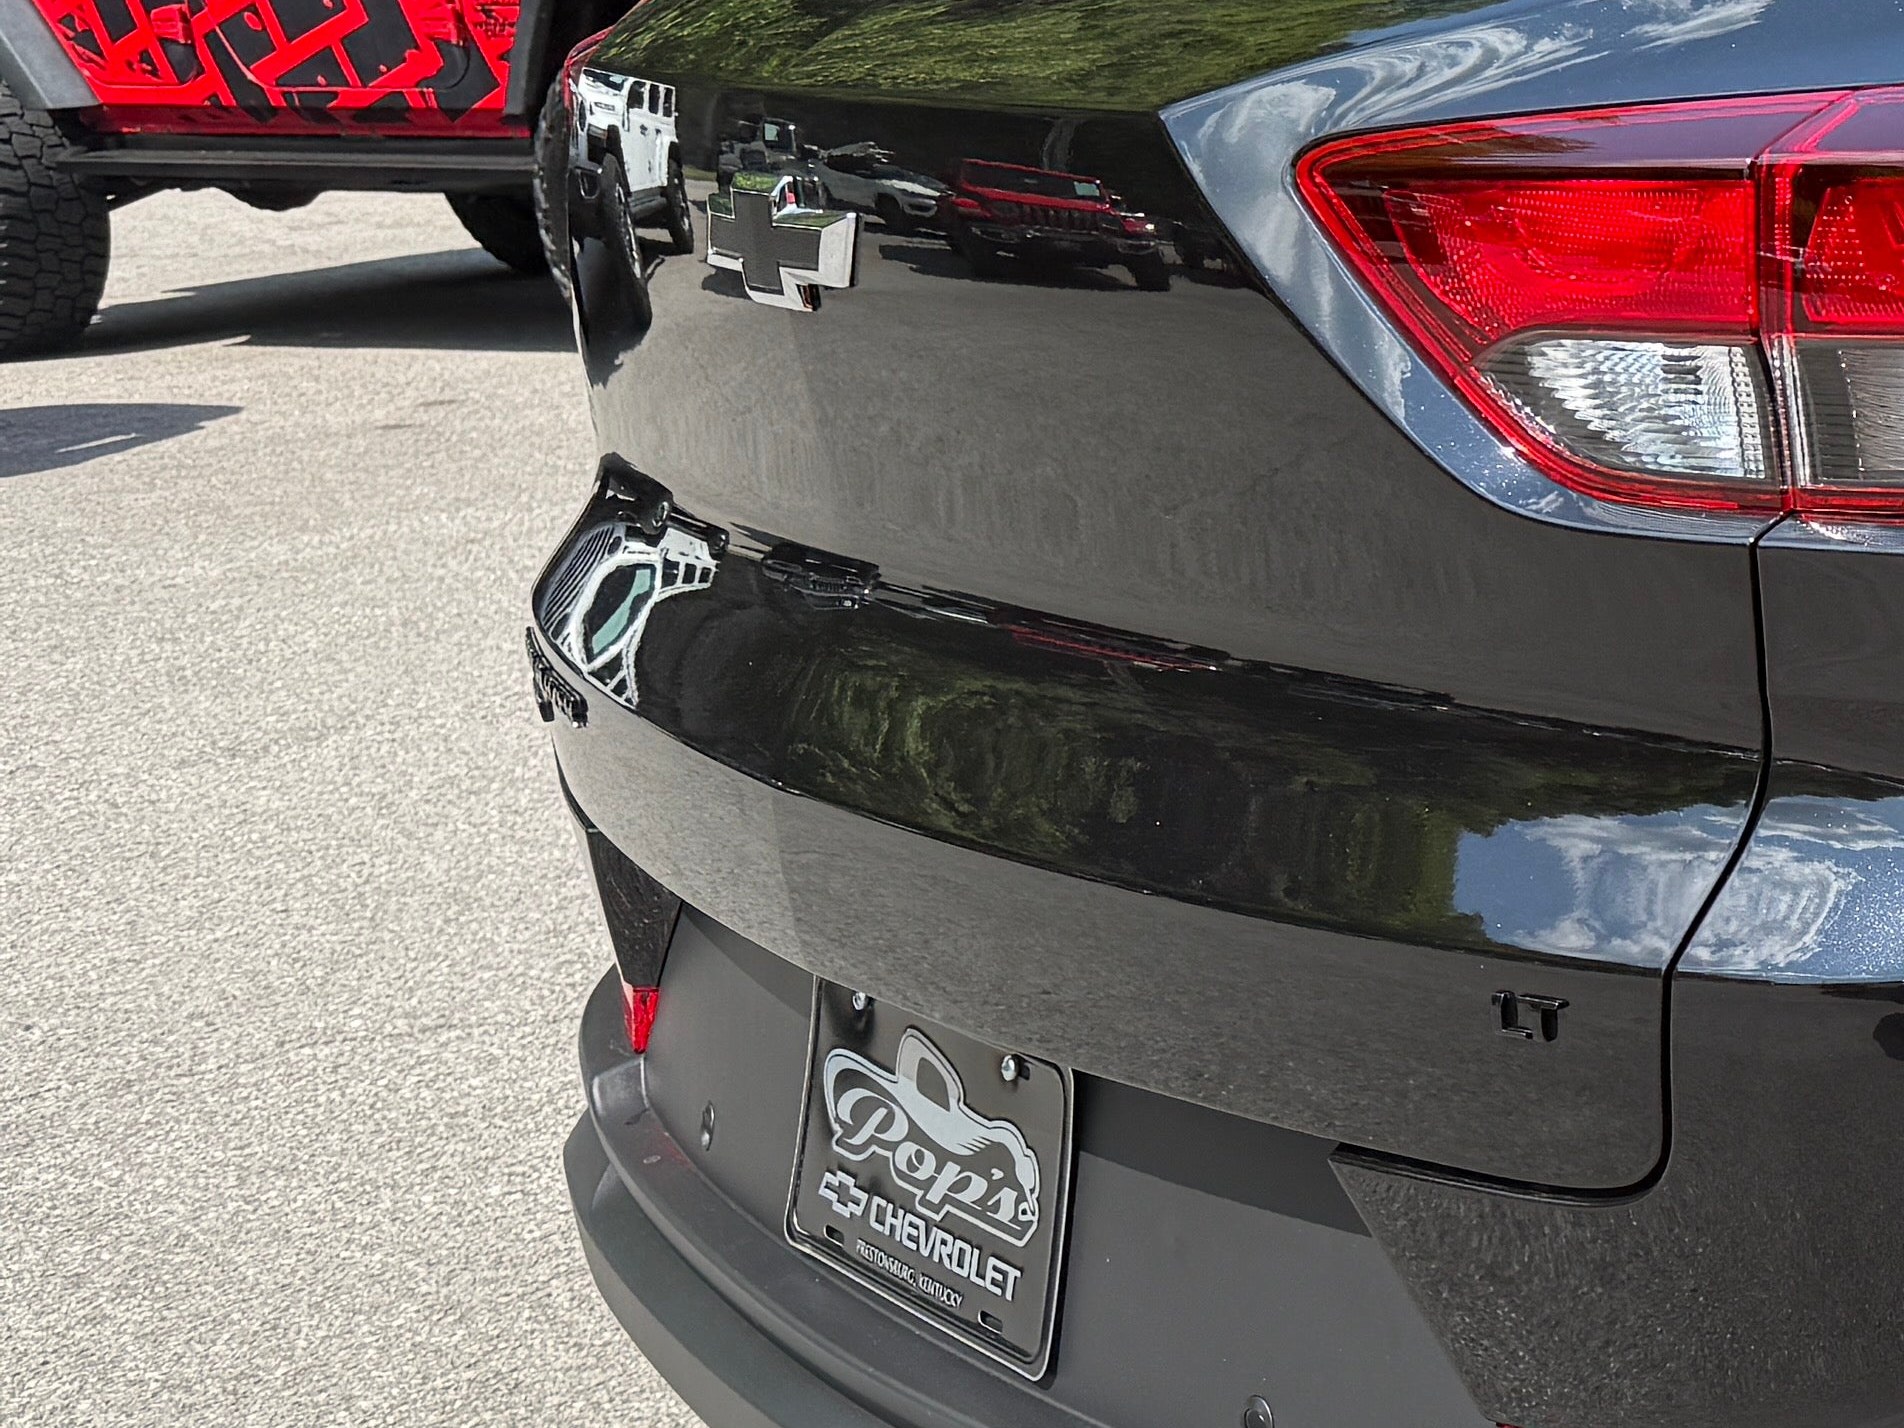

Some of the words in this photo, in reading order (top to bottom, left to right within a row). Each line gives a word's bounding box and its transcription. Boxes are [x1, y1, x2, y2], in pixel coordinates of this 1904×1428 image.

[1491, 990, 1570, 1043] LT
[836, 1087, 1030, 1229] Pop's
[867, 1194, 1022, 1302] CHEVROLET
[918, 1272, 965, 1308] KENTUCKY
